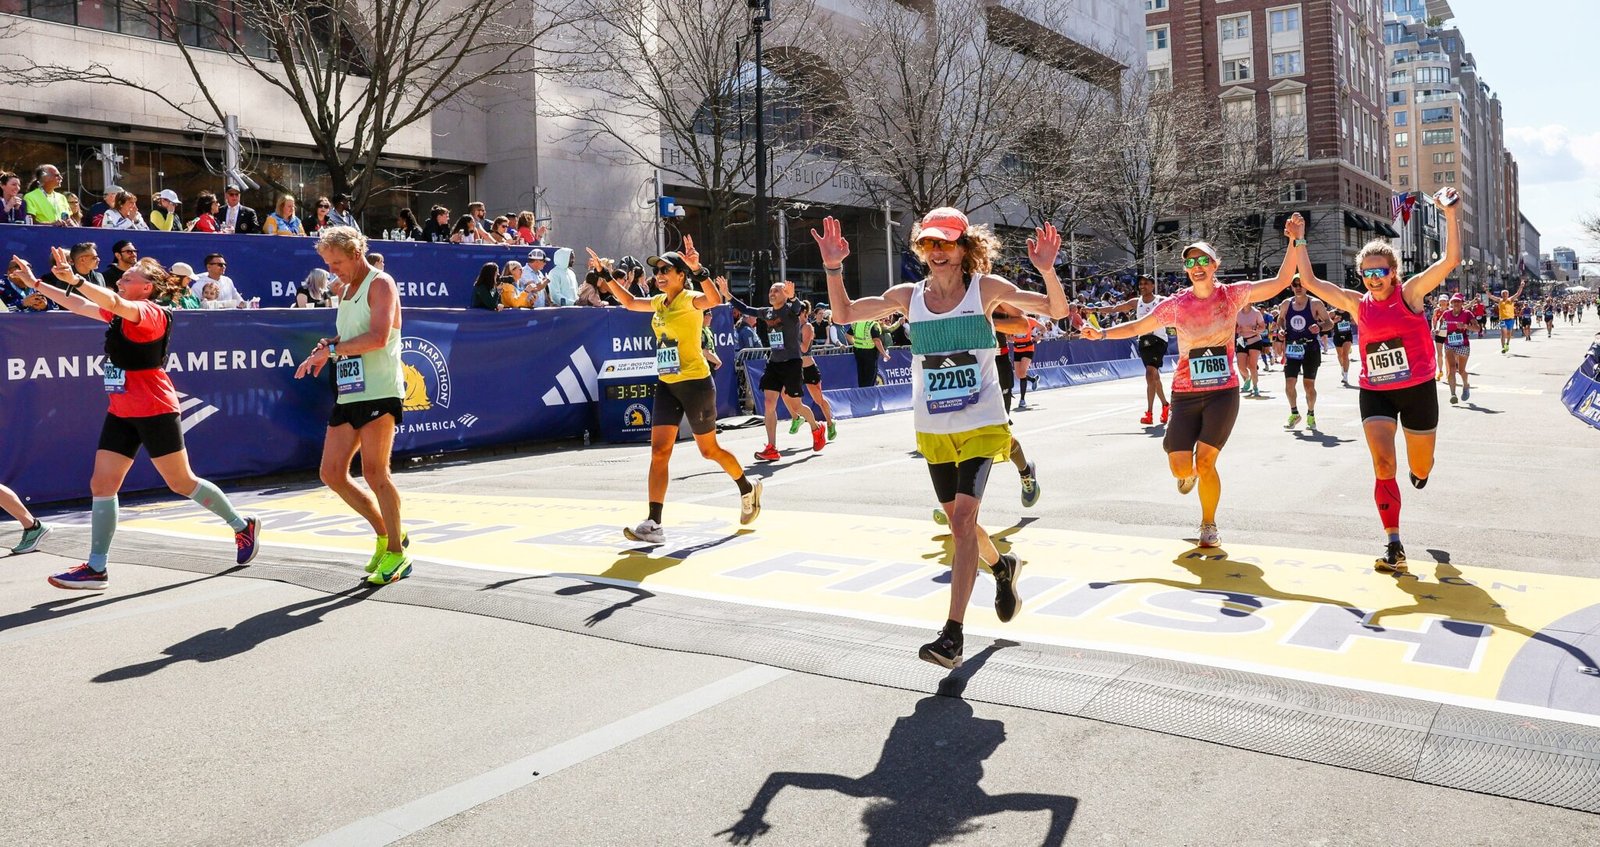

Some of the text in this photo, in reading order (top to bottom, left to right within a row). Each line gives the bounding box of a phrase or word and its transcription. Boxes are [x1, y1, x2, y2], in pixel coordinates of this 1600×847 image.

[397, 281, 449, 297] ERICA
[612, 336, 653, 353] BANK
[7, 348, 295, 380] BANK AMERICA
[1193, 358, 1226, 374] 17686
[1369, 351, 1404, 370] 14518
[418, 342, 449, 402] MARATHON
[928, 368, 977, 391] 22203
[617, 384, 657, 400] 3:53:
[408, 420, 457, 433] AMERICA
[719, 551, 1488, 671] FINISH
